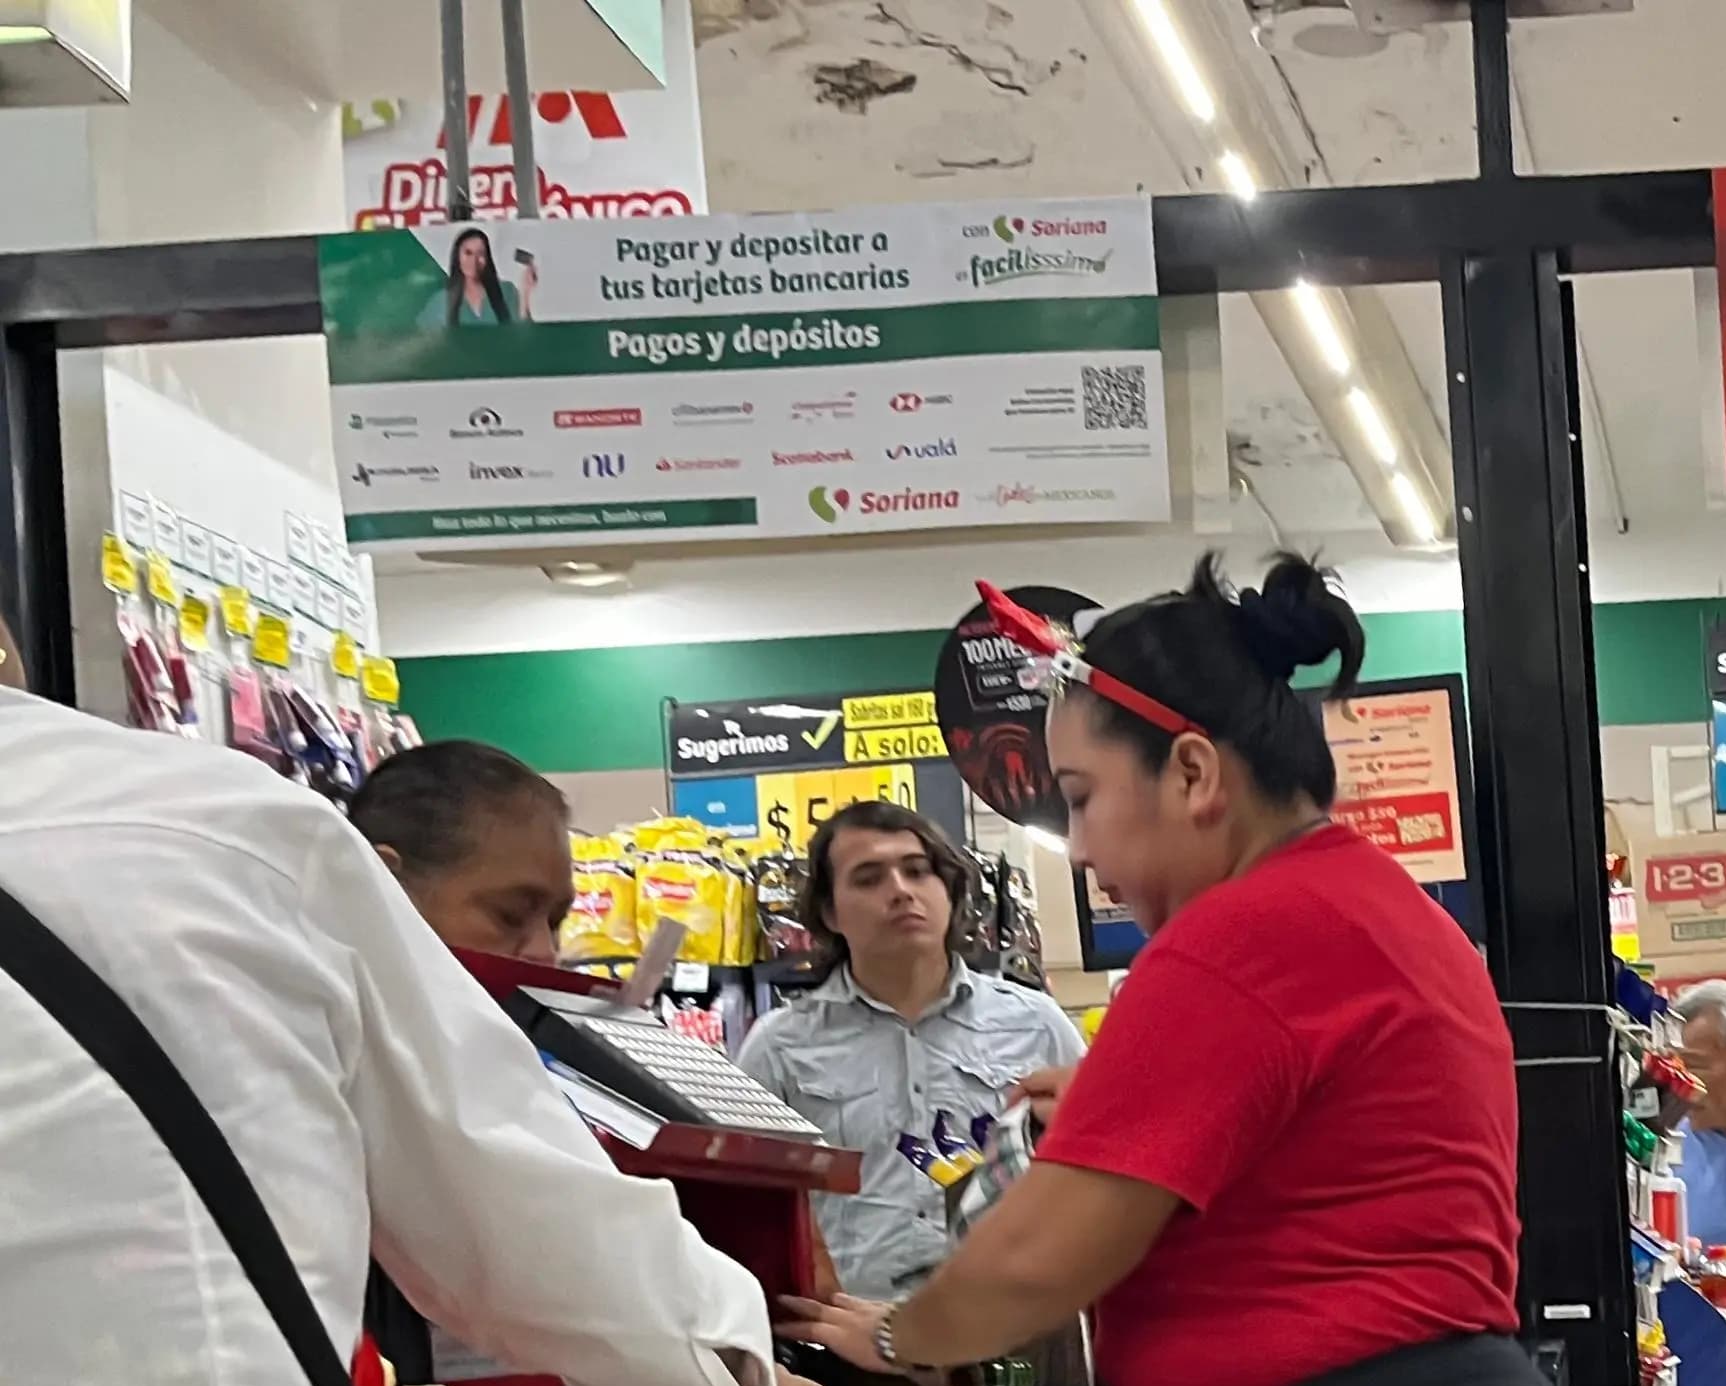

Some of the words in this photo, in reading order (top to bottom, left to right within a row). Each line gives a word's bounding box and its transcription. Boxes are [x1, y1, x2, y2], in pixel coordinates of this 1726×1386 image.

[962, 225, 989, 238] con
[1031, 217, 1107, 237] Soriana
[616, 237, 700, 268] Pagar
[705, 239, 722, 266] y
[730, 228, 864, 264] depositar
[871, 231, 889, 252] a
[600, 274, 646, 301] tus
[652, 269, 763, 303] tarjetas
[770, 263, 910, 294] bancarias
[608, 329, 701, 364] Pagos
[706, 331, 726, 362] y
[732, 317, 881, 360] depósitos
[859, 486, 959, 514] Soriana
[678, 734, 790, 764] Sugerimos
[854, 731, 871, 759] A
[878, 728, 939, 757] solo:
